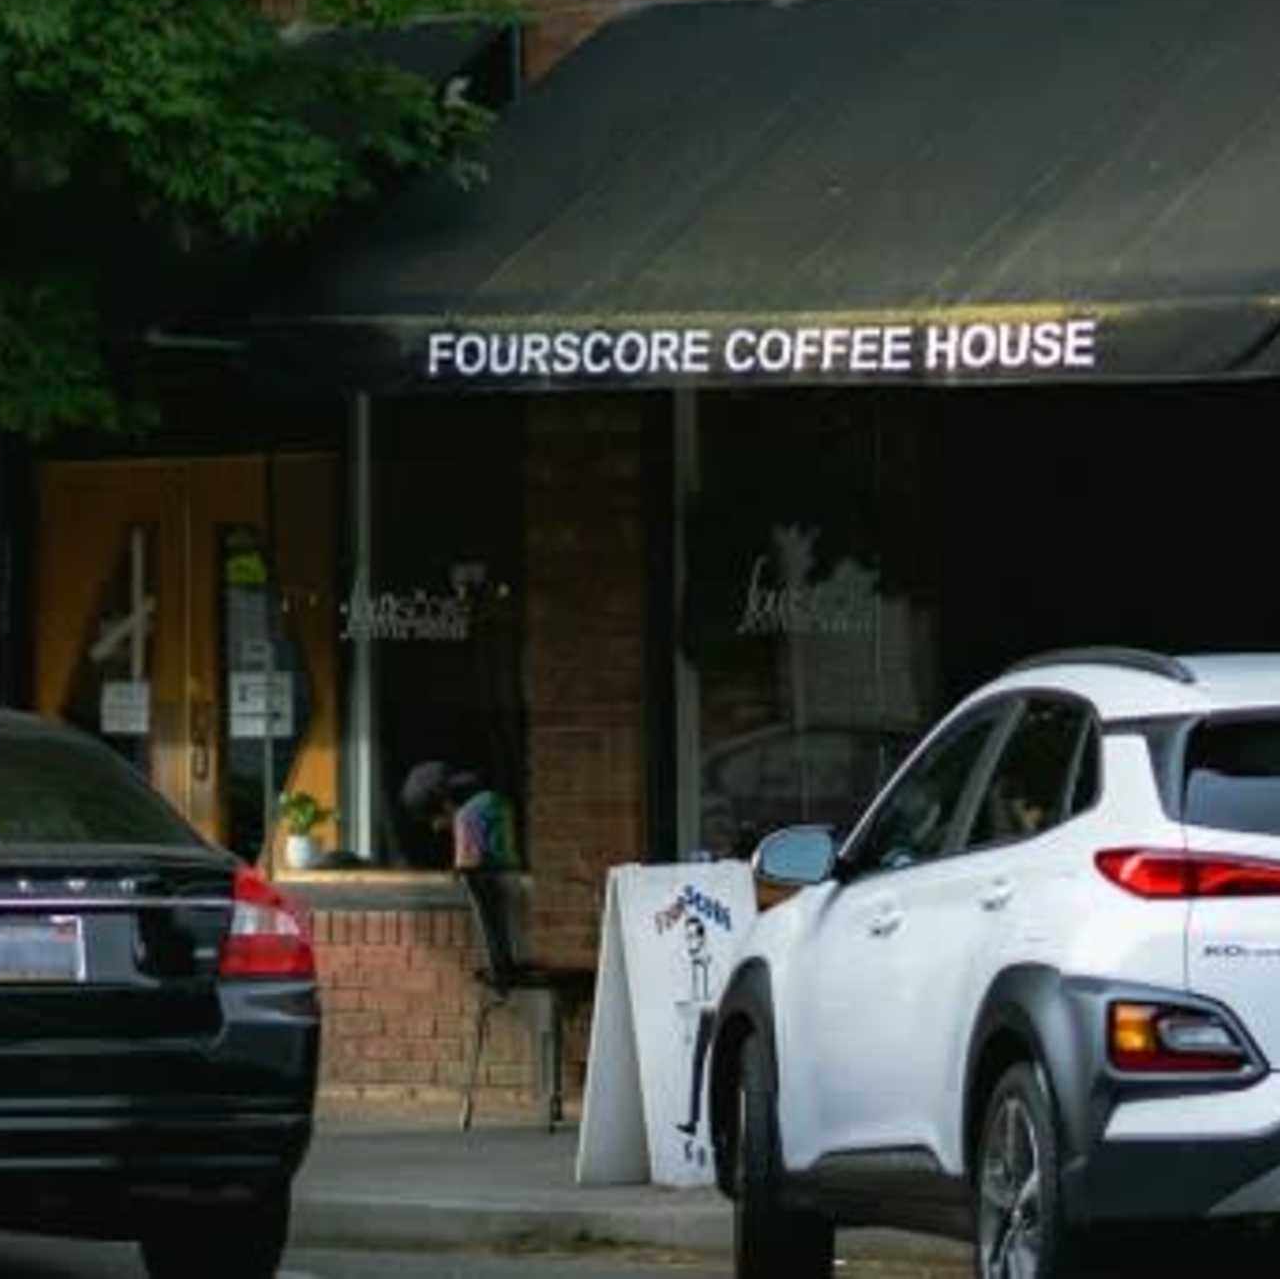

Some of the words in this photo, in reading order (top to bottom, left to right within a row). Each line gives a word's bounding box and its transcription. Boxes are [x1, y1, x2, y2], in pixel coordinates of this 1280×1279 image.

[427, 329, 710, 375] FOURSCORE
[724, 325, 913, 373] COFFEE
[924, 320, 1096, 370] HOUSE
